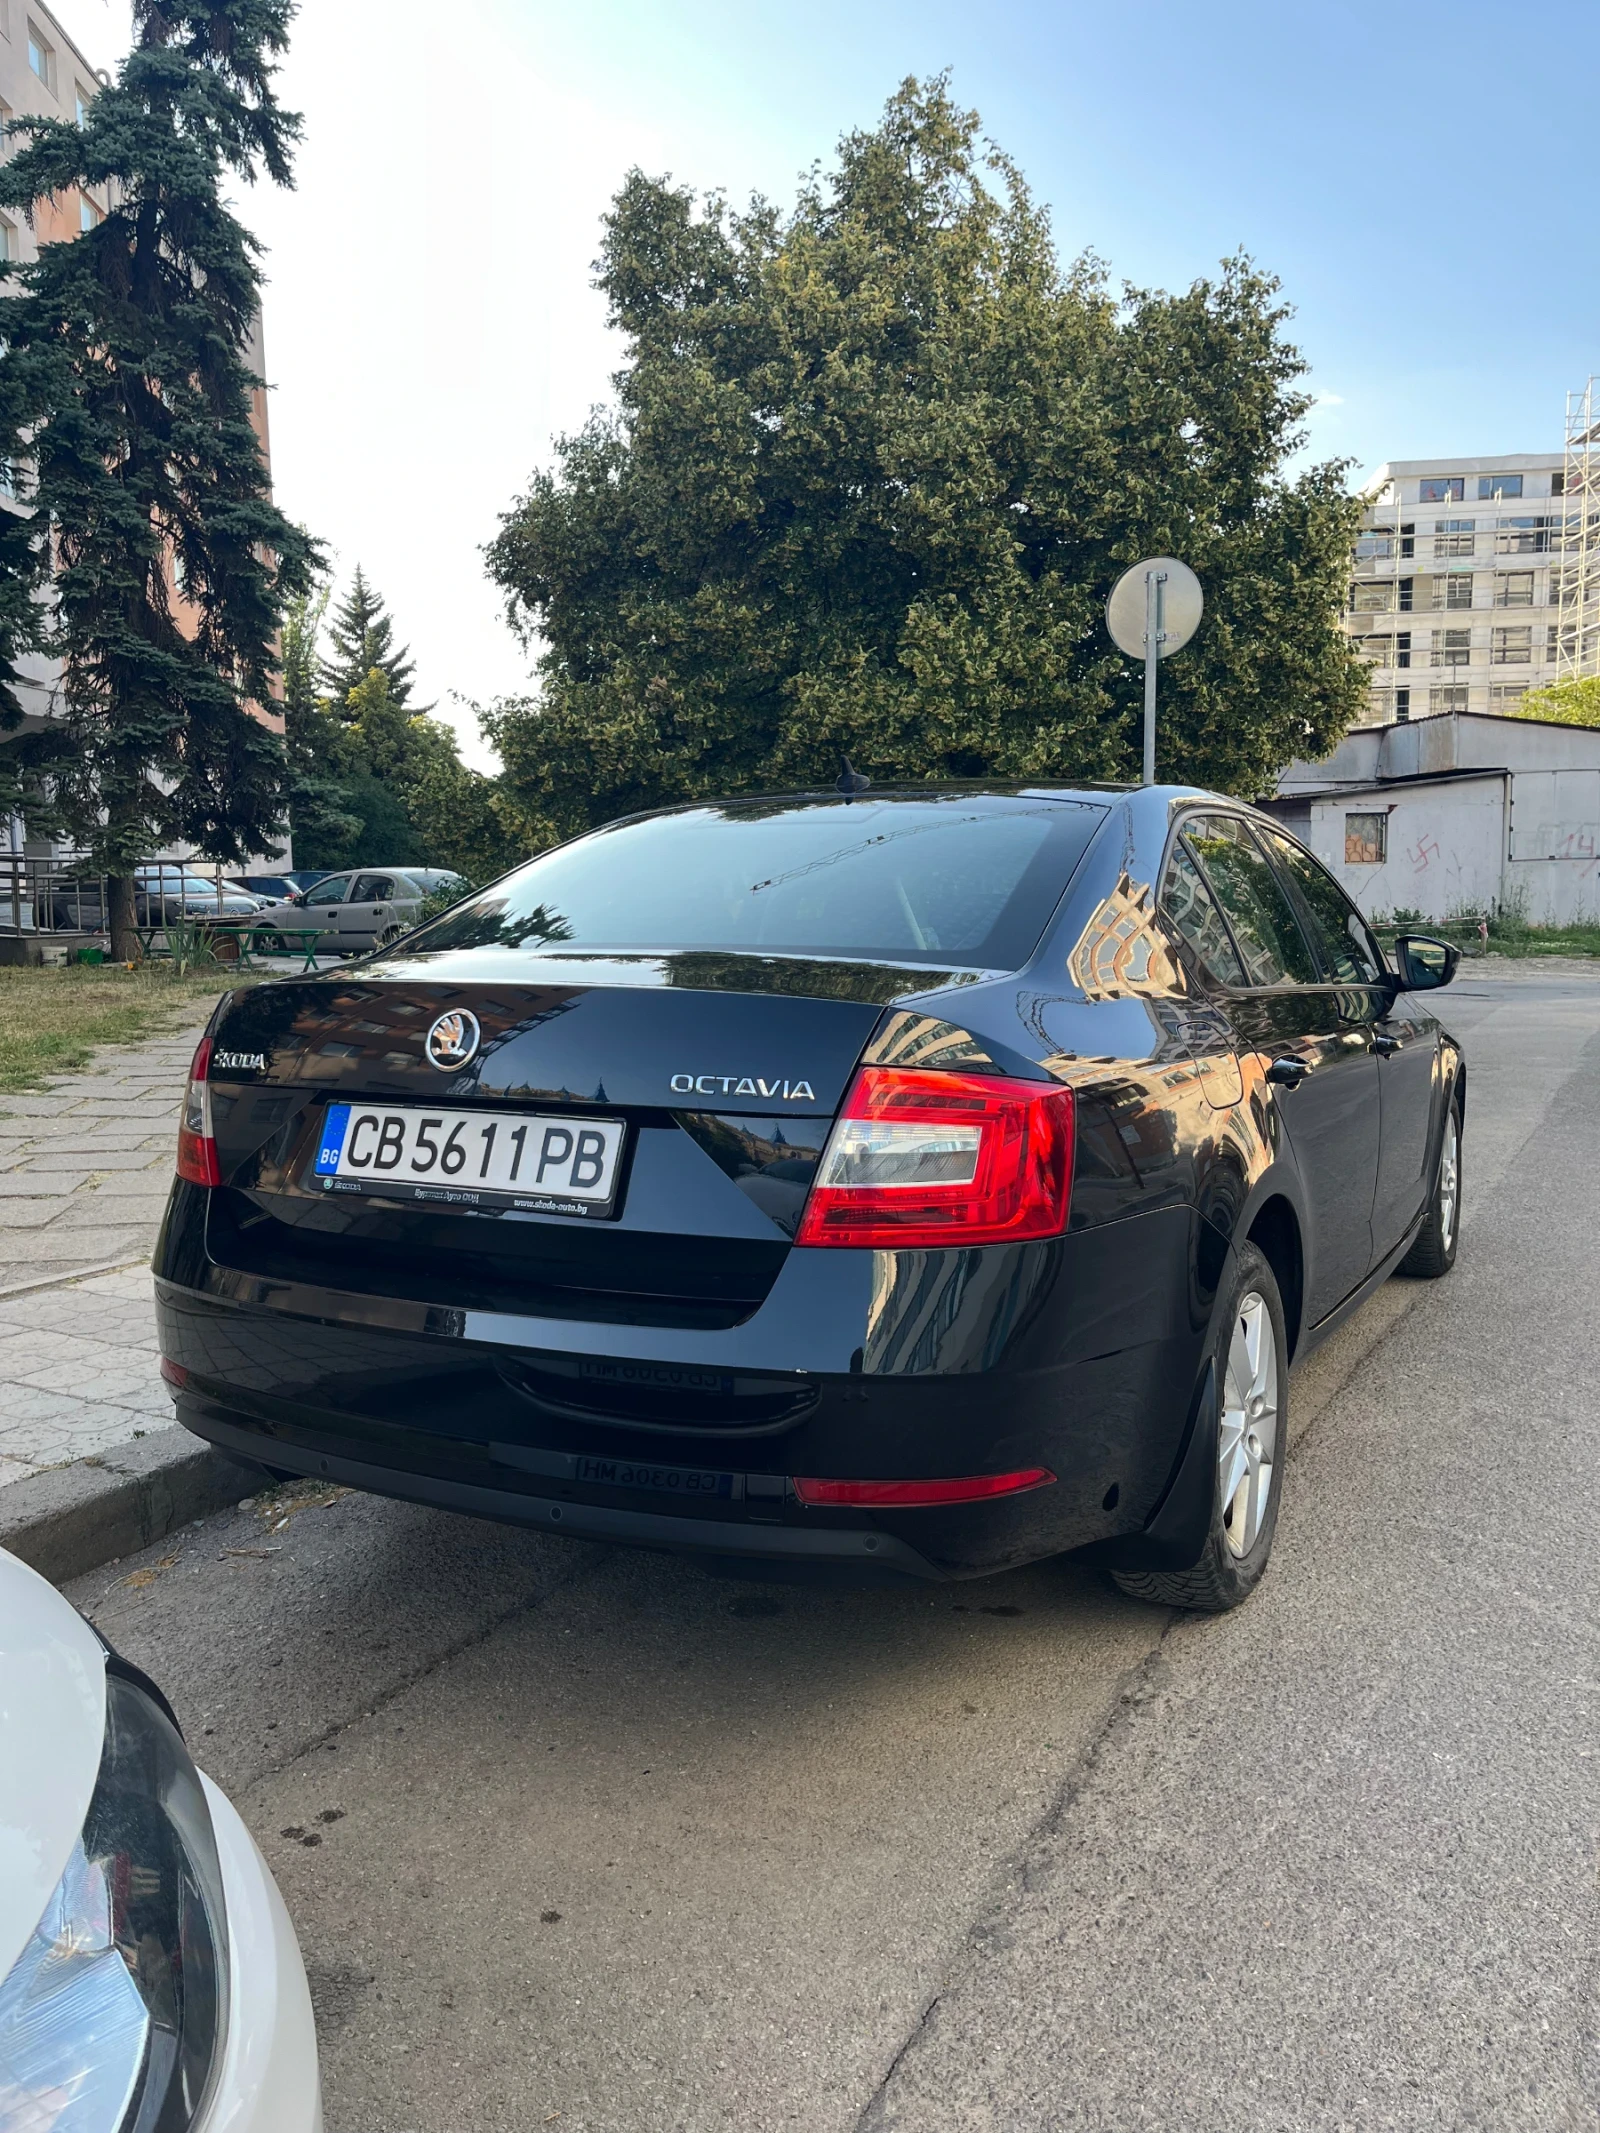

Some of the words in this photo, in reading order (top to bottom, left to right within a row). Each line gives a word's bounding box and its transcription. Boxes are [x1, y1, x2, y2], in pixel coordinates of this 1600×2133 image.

[213, 1048, 266, 1070] ŠKODA
[670, 1074, 815, 1100] OCTAVIA
[320, 1148, 339, 1165] BG
[514, 1199, 588, 1215] www.skoda-auto.bg
